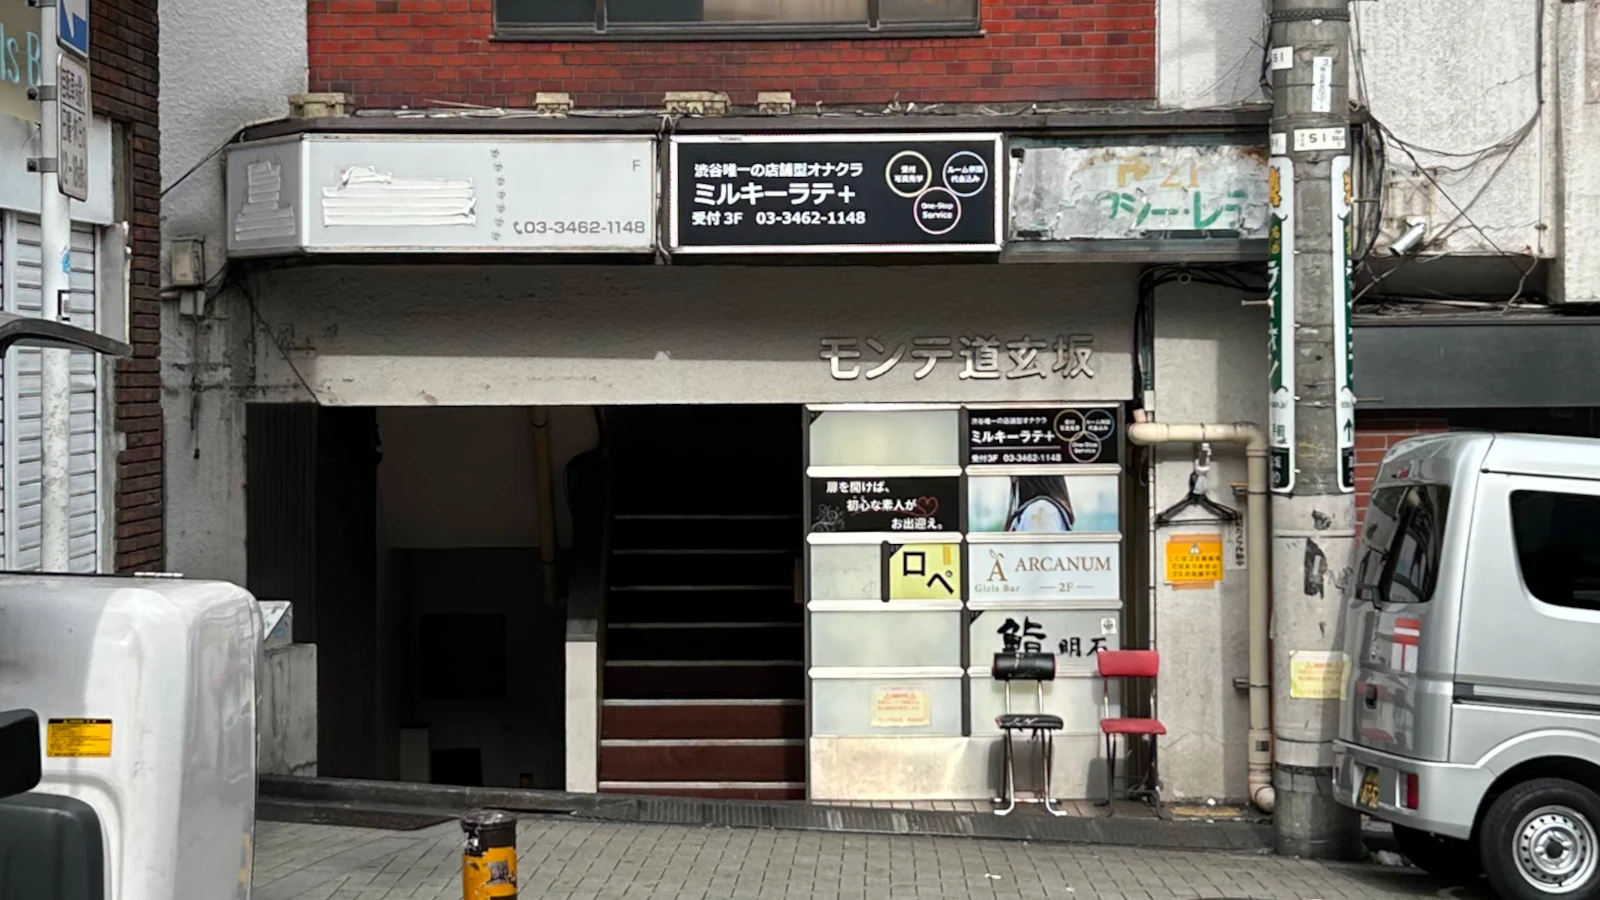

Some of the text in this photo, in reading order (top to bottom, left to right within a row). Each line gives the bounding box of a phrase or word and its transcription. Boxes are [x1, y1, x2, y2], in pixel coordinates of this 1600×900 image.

[632, 159, 642, 172] F
[692, 161, 865, 179] 渋谷唯一の店舗型オナクラ
[755, 210, 867, 226] 03-3462-1148
[921, 210, 954, 220] Service
[524, 220, 646, 235] 03-3462-1148
[819, 334, 1095, 380] モンテ道玄坂
[1002, 453, 1063, 463] 03-3462-1148
[1014, 555, 1112, 572] ARCANUM
[974, 583, 1021, 593] Girls Bar
[1058, 582, 1074, 593] 2F
